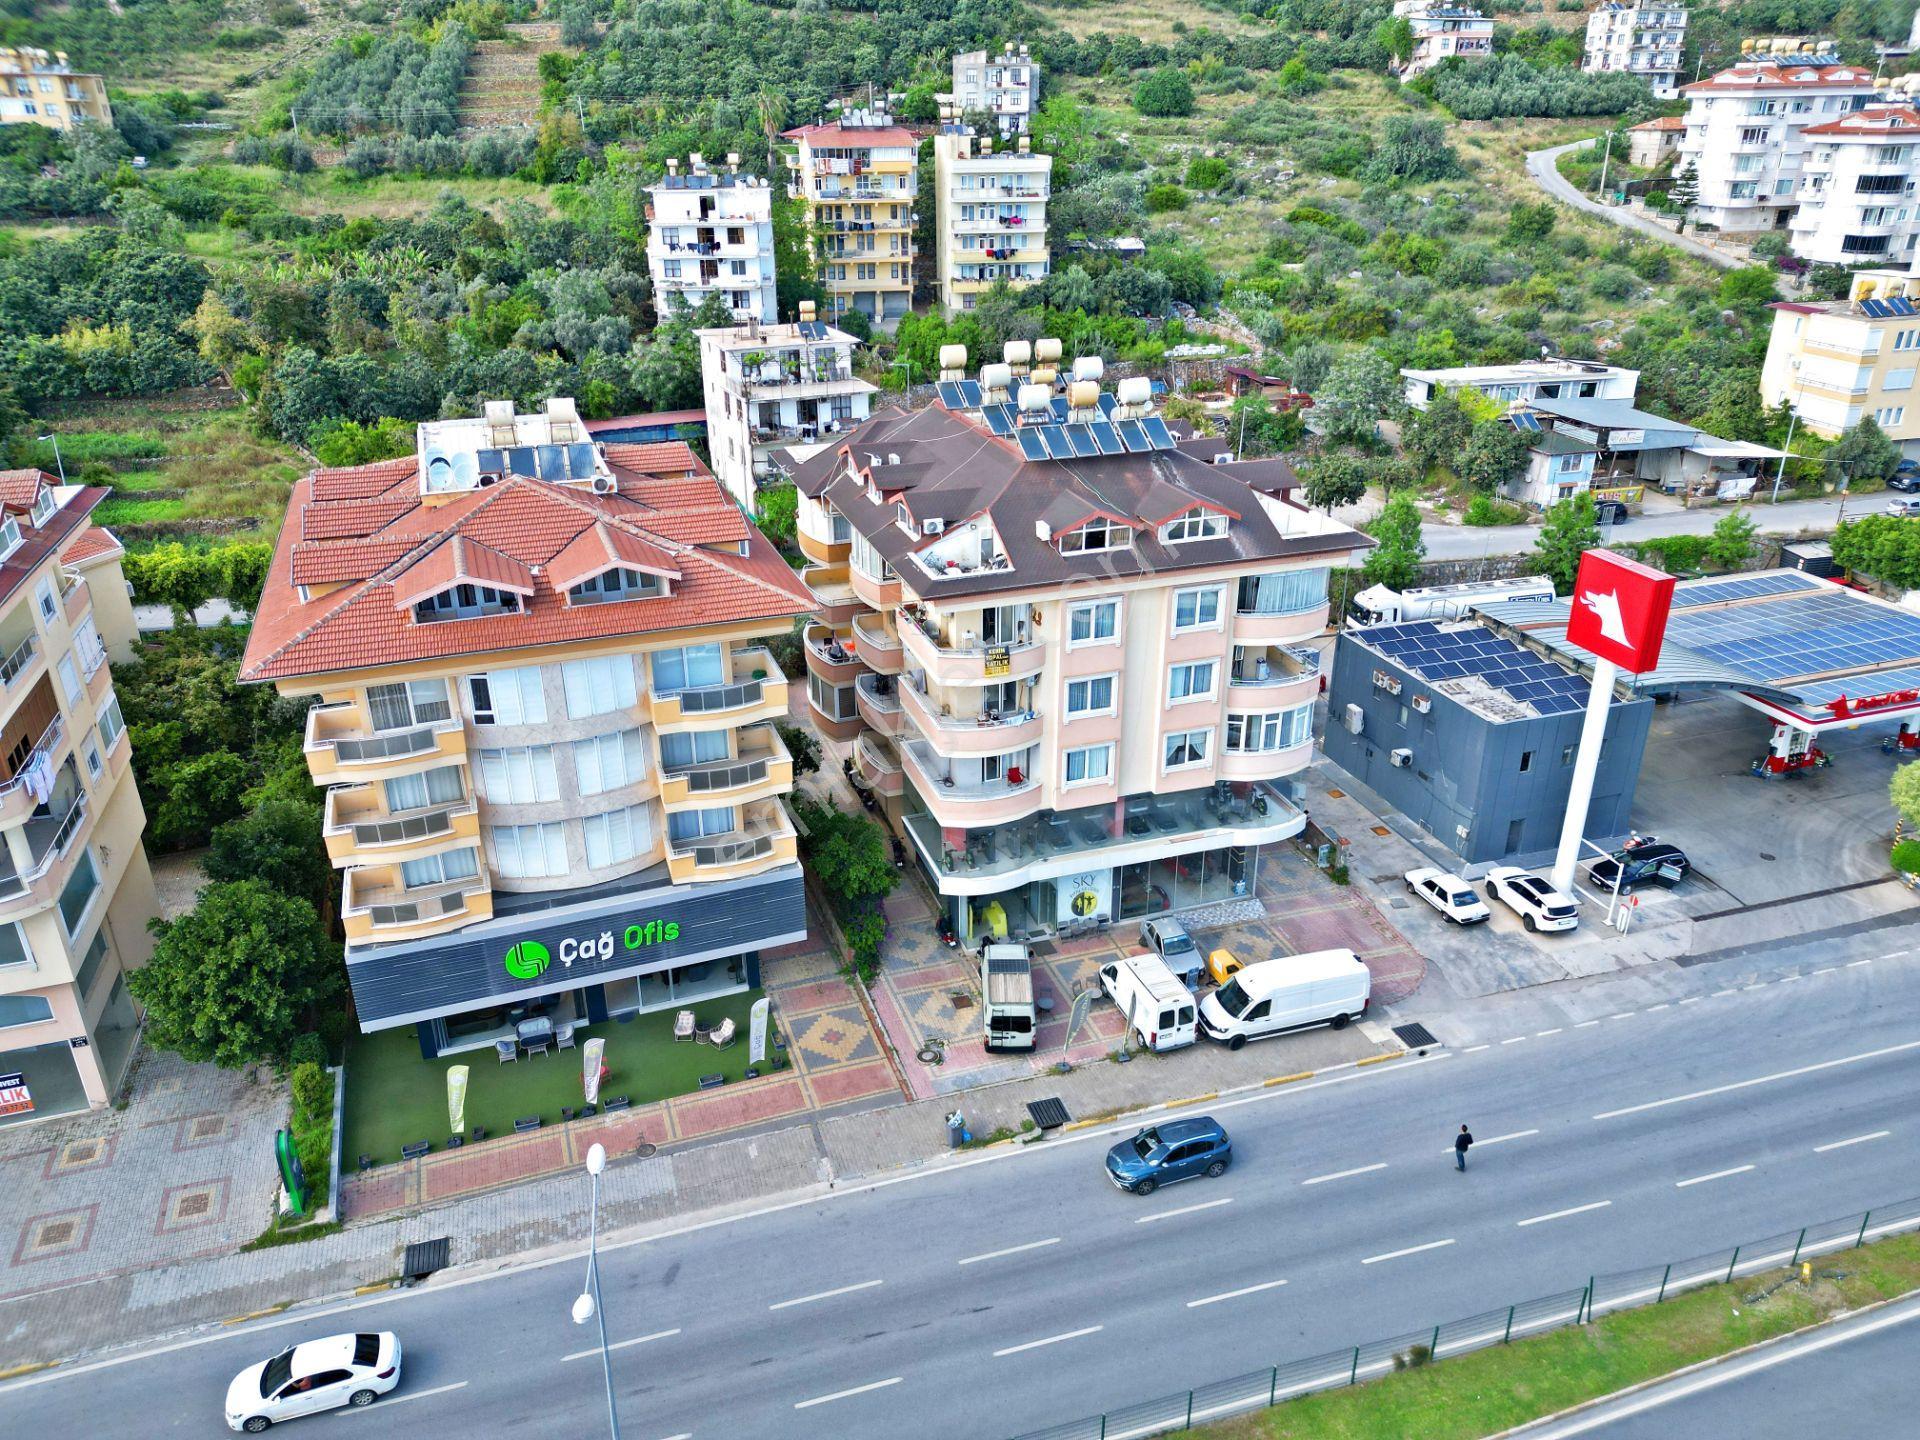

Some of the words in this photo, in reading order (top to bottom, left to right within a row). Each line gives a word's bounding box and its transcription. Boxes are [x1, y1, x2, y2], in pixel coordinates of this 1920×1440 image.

[1072, 874, 1097, 889] SKY
[559, 930, 614, 967] Çağ
[625, 920, 680, 950] Ofis
[0, 1087, 28, 1104] LIK
